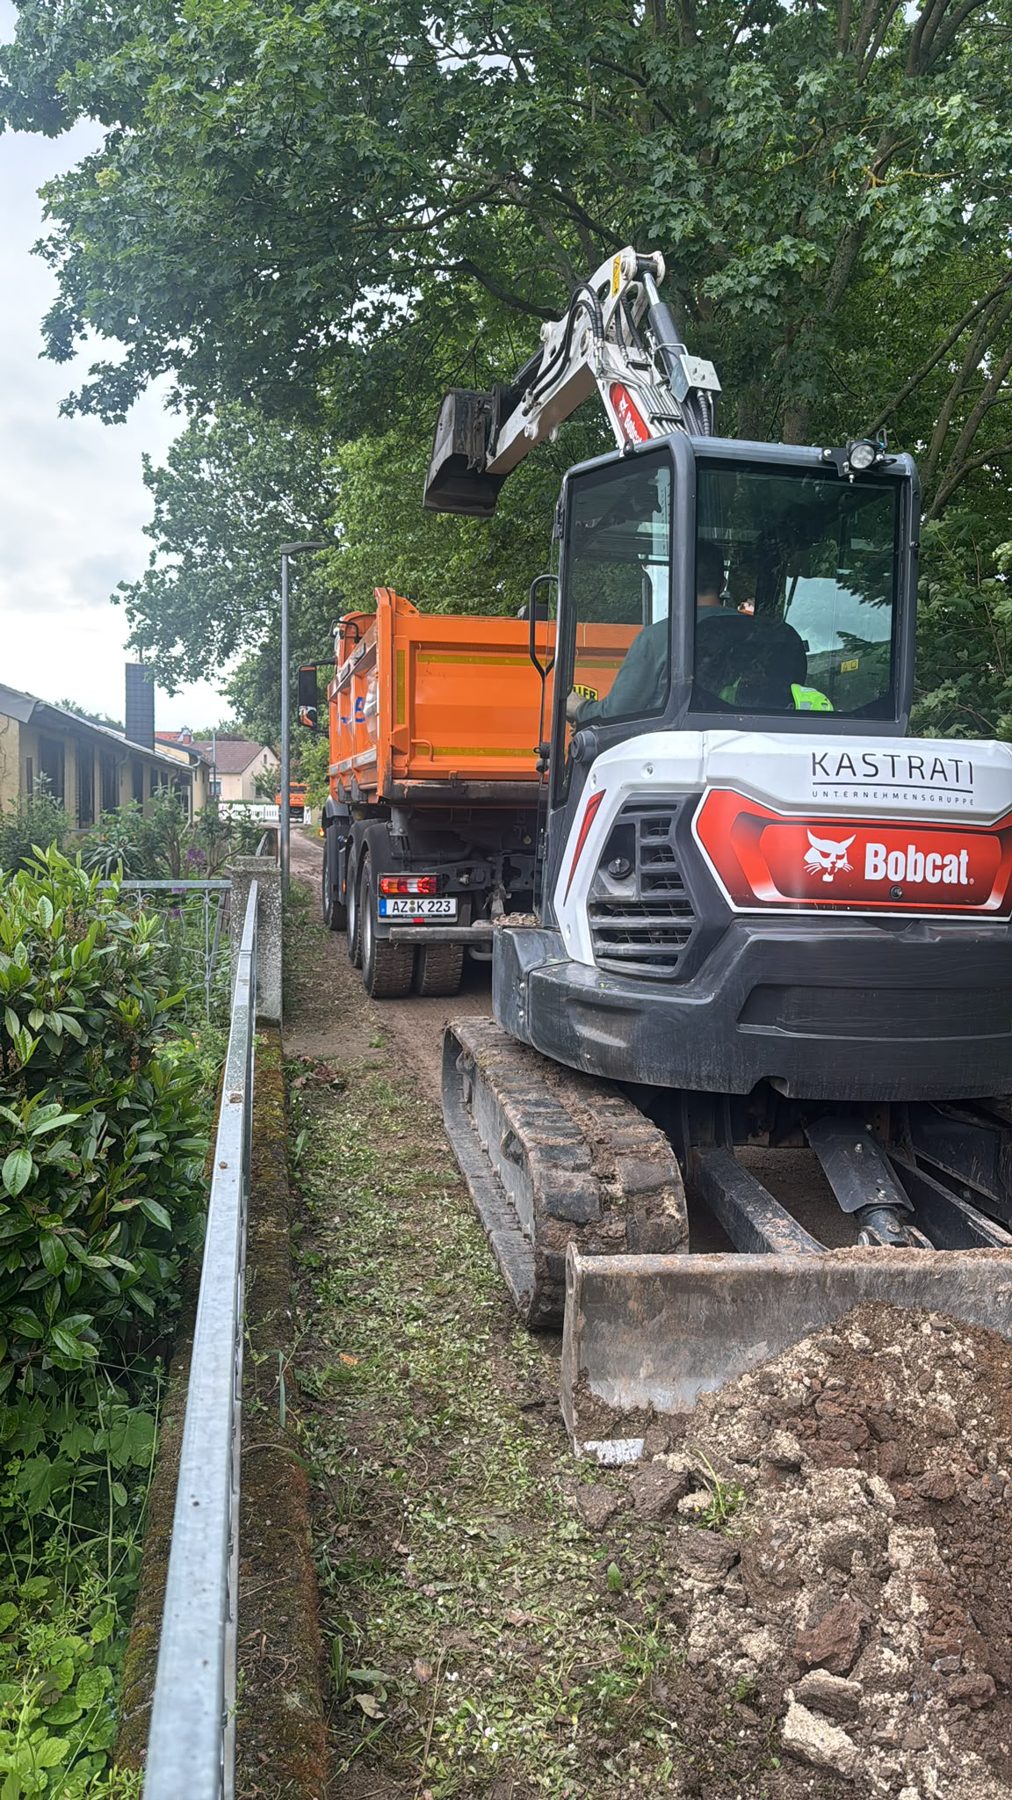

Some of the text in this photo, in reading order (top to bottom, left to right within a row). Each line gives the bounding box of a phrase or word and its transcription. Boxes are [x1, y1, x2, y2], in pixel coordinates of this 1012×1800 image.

[812, 752, 974, 785] KASTRATI
[812, 790, 975, 806] UNTERNEHMENSGRUPPE
[864, 842, 969, 885] Bobcat
